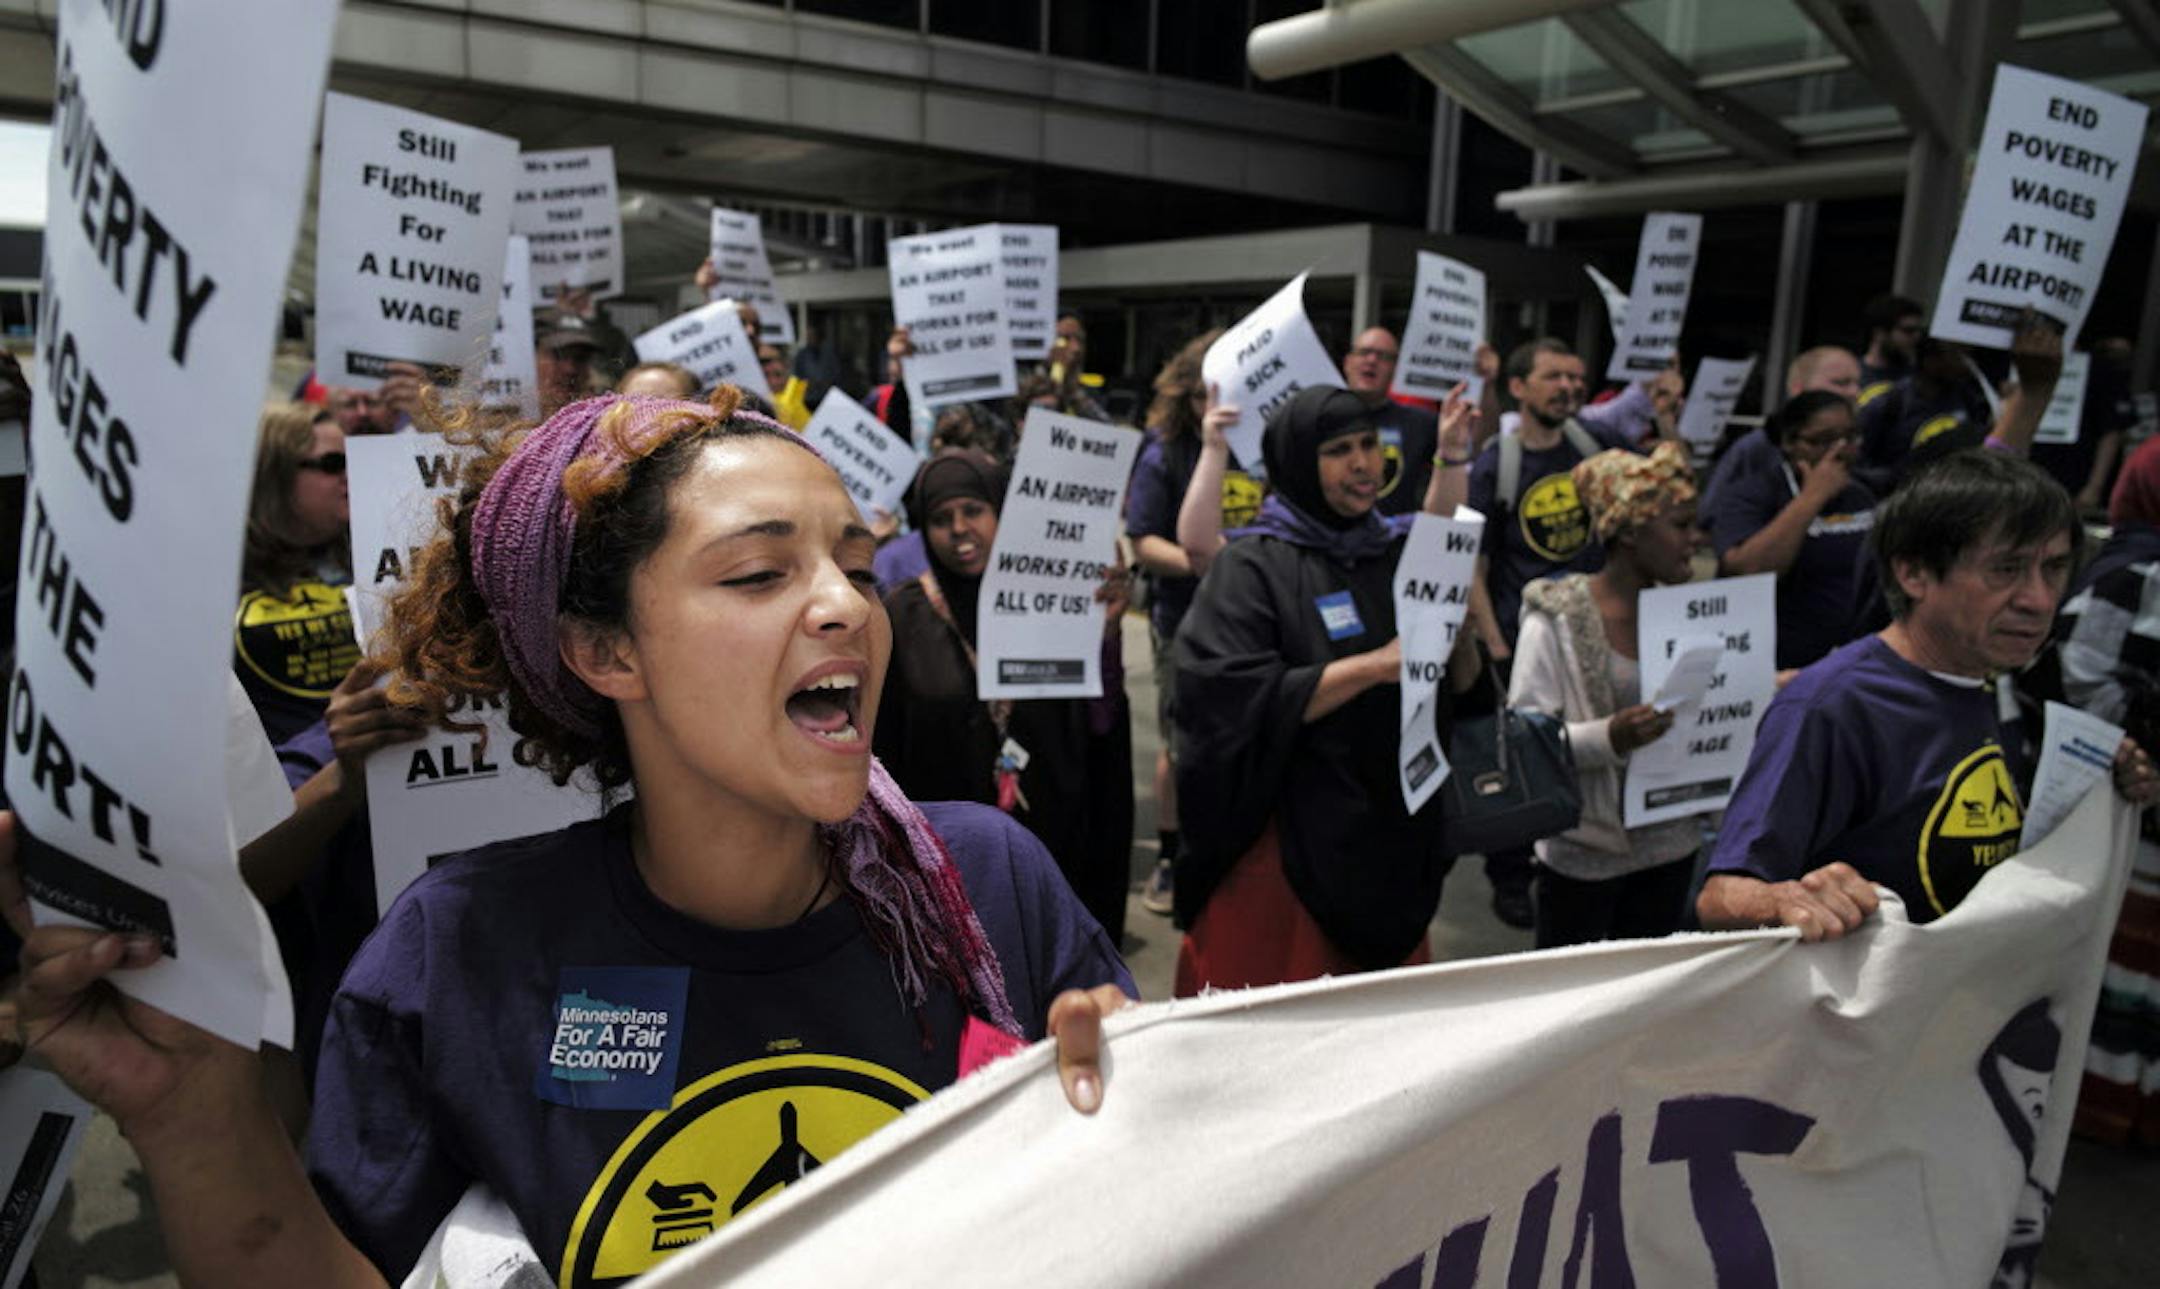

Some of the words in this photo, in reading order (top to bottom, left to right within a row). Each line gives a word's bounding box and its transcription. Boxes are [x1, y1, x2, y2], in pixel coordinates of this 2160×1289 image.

[2047, 97, 2099, 131] END
[397, 128, 456, 163] Still
[2004, 131, 2118, 181] POVERTY
[362, 164, 482, 216] Fighting
[2011, 178, 2097, 221] WAGES
[400, 214, 446, 243] For
[2002, 223, 2038, 249] AT
[2045, 231, 2086, 263] THE
[358, 252, 379, 275] A
[389, 257, 481, 293] LIVING
[898, 274, 919, 288] AN
[924, 263, 993, 284] AIRPORT
[380, 297, 463, 330] WAGE
[927, 290, 966, 307] THAT
[670, 321, 705, 344] END
[965, 309, 999, 325] FOR
[942, 337, 963, 351] OF
[1237, 328, 1274, 364] PAID
[1245, 356, 1287, 393] SICK
[853, 421, 889, 452] END
[1050, 426, 1077, 450] We
[1082, 439, 1118, 459] want
[821, 425, 895, 486] POVERTY
[1017, 475, 1048, 499] AN
[1051, 481, 1118, 509] AIRPORT
[1045, 519, 1087, 542] THAT
[997, 551, 1069, 579] WORKS
[29, 488, 105, 690] THE
[995, 591, 1028, 615] ALL
[1033, 593, 1058, 613] OF
[1061, 595, 1090, 616] US!
[1404, 579, 1440, 601] AN
[1687, 597, 1727, 621] Still
[406, 742, 499, 785] ALL
[560, 1007, 668, 1025] Minnesotans
[555, 1024, 594, 1046] For
[596, 1024, 616, 1047] A
[621, 1024, 667, 1048] Fair
[549, 1042, 663, 1075] Economy
